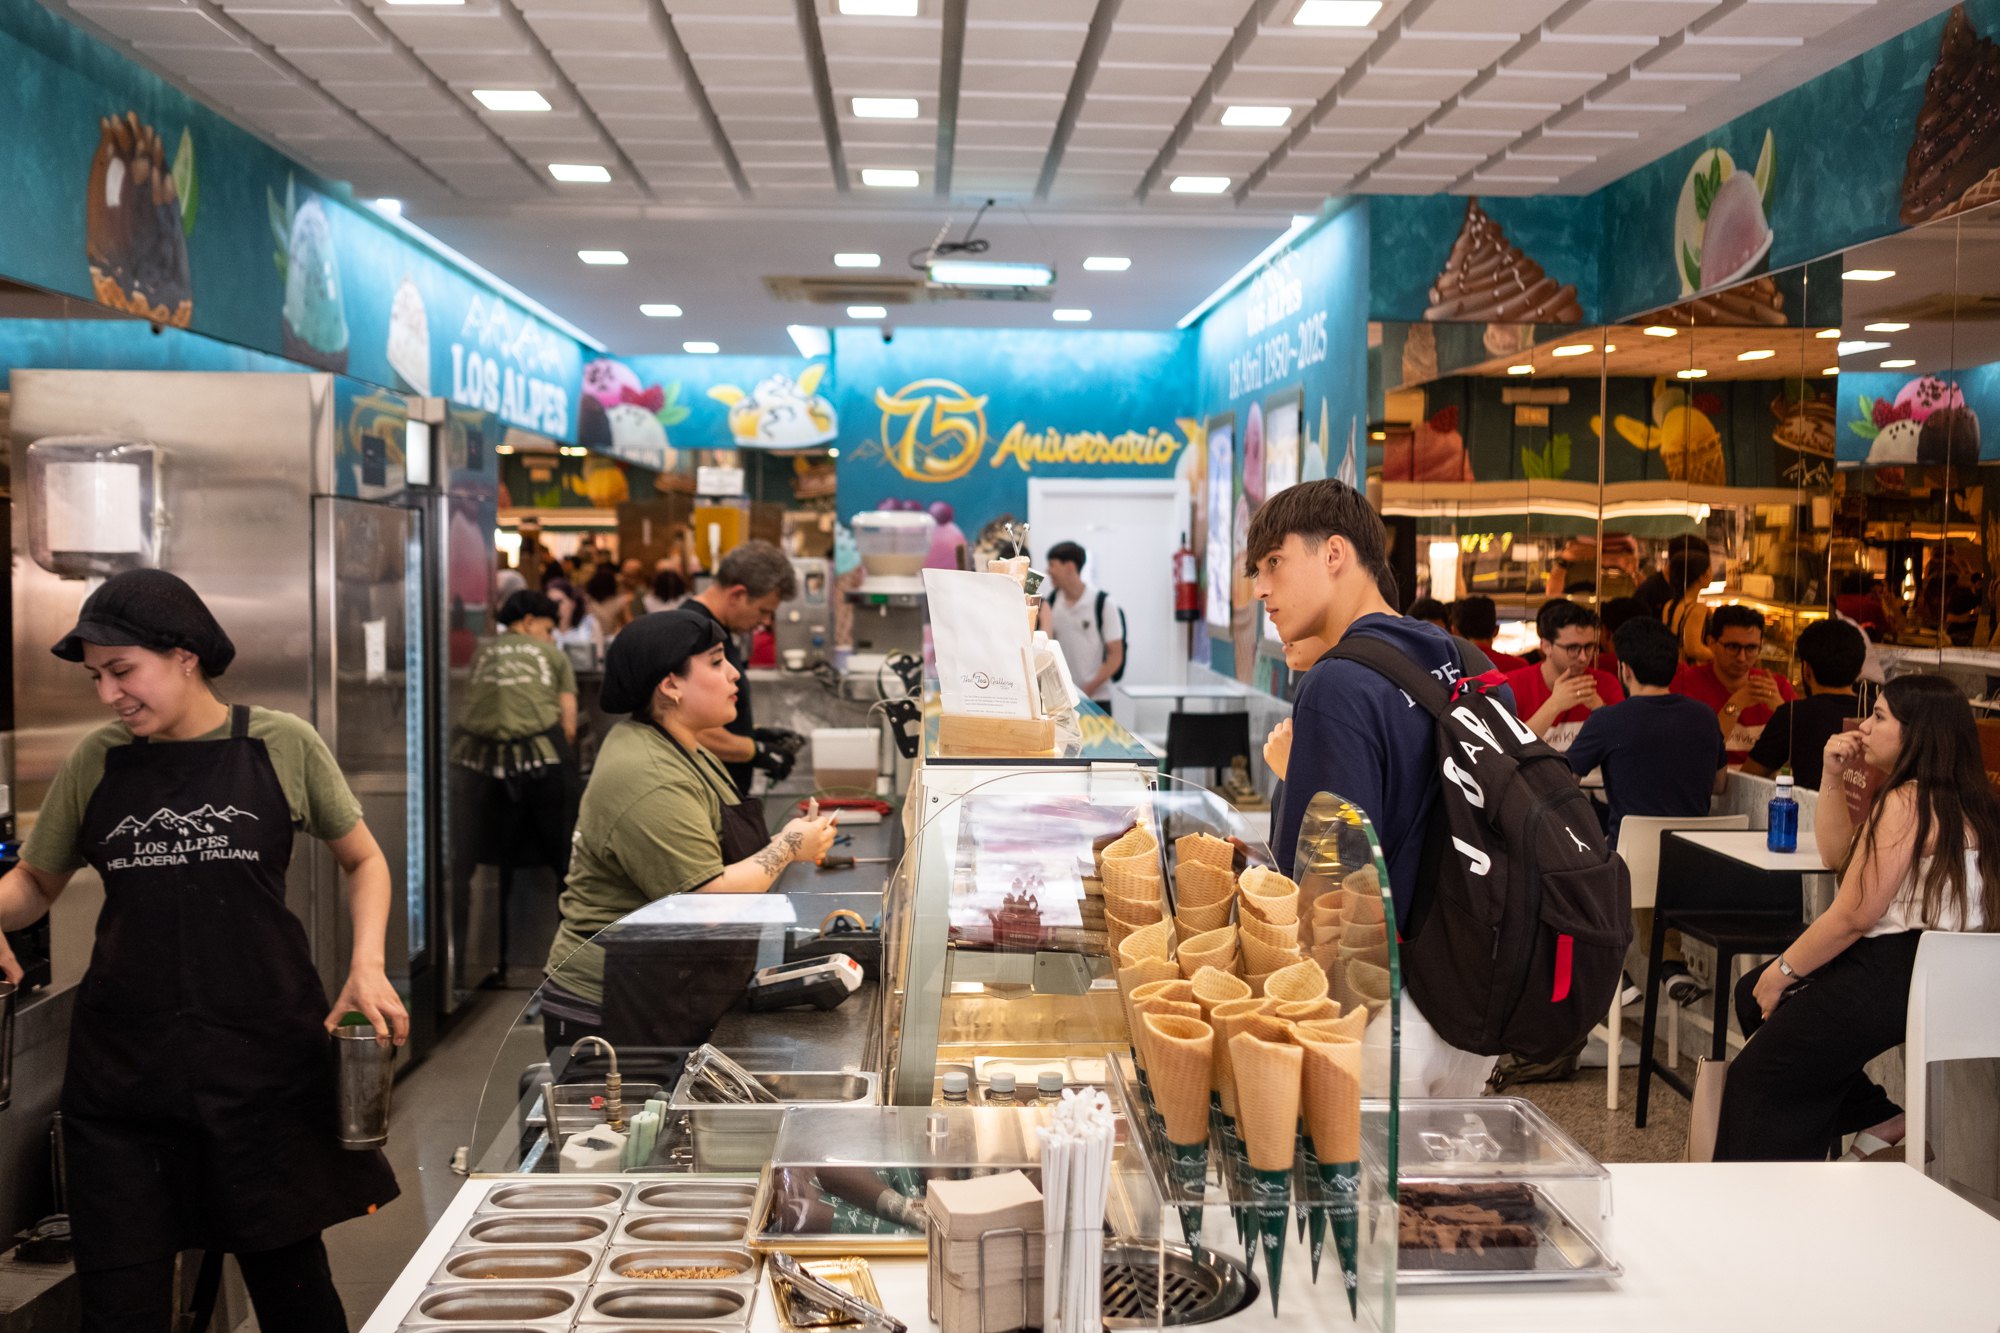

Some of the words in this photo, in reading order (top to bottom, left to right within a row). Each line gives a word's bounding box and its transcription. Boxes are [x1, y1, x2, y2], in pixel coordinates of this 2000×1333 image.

[451, 343, 500, 415] LOS
[501, 366, 569, 438] ALPES
[875, 386, 990, 472] 75
[989, 421, 1181, 472] Aniversario
[961, 675, 974, 684] The
[989, 677, 1014, 689] Gallery
[133, 842, 167, 855] LOS
[171, 835, 229, 853] ALPES
[107, 854, 189, 872] HELADERIA
[200, 848, 260, 862] ITALIANA
